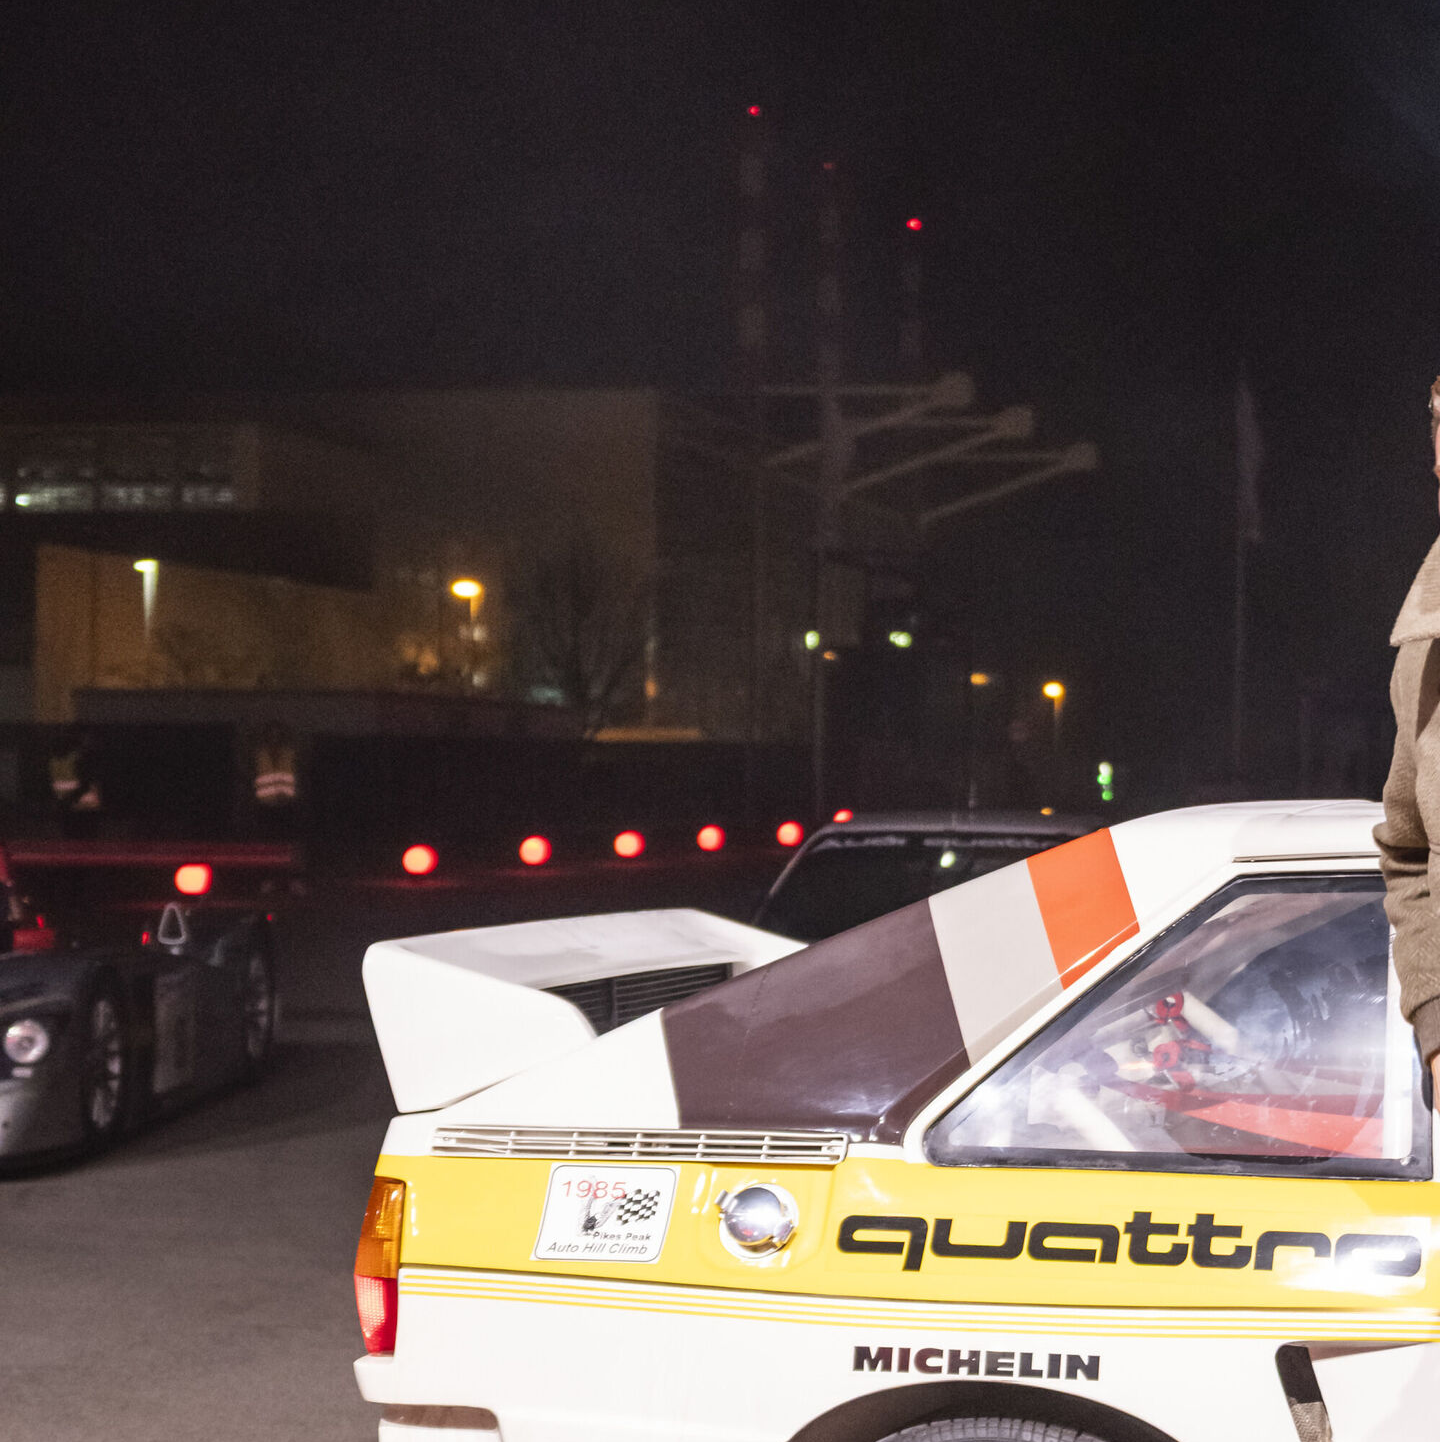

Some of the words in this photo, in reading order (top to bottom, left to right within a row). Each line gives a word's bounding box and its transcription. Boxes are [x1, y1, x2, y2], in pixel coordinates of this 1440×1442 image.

[562, 1180, 626, 1200] 1985
[593, 1231, 622, 1241] Pikes
[626, 1232, 652, 1242] Peak
[837, 1211, 1422, 1278] quattro
[547, 1242, 579, 1254] Auto
[581, 1243, 605, 1254] Hill
[609, 1243, 648, 1255] Climb
[853, 1345, 1101, 1381] MICHELIN
